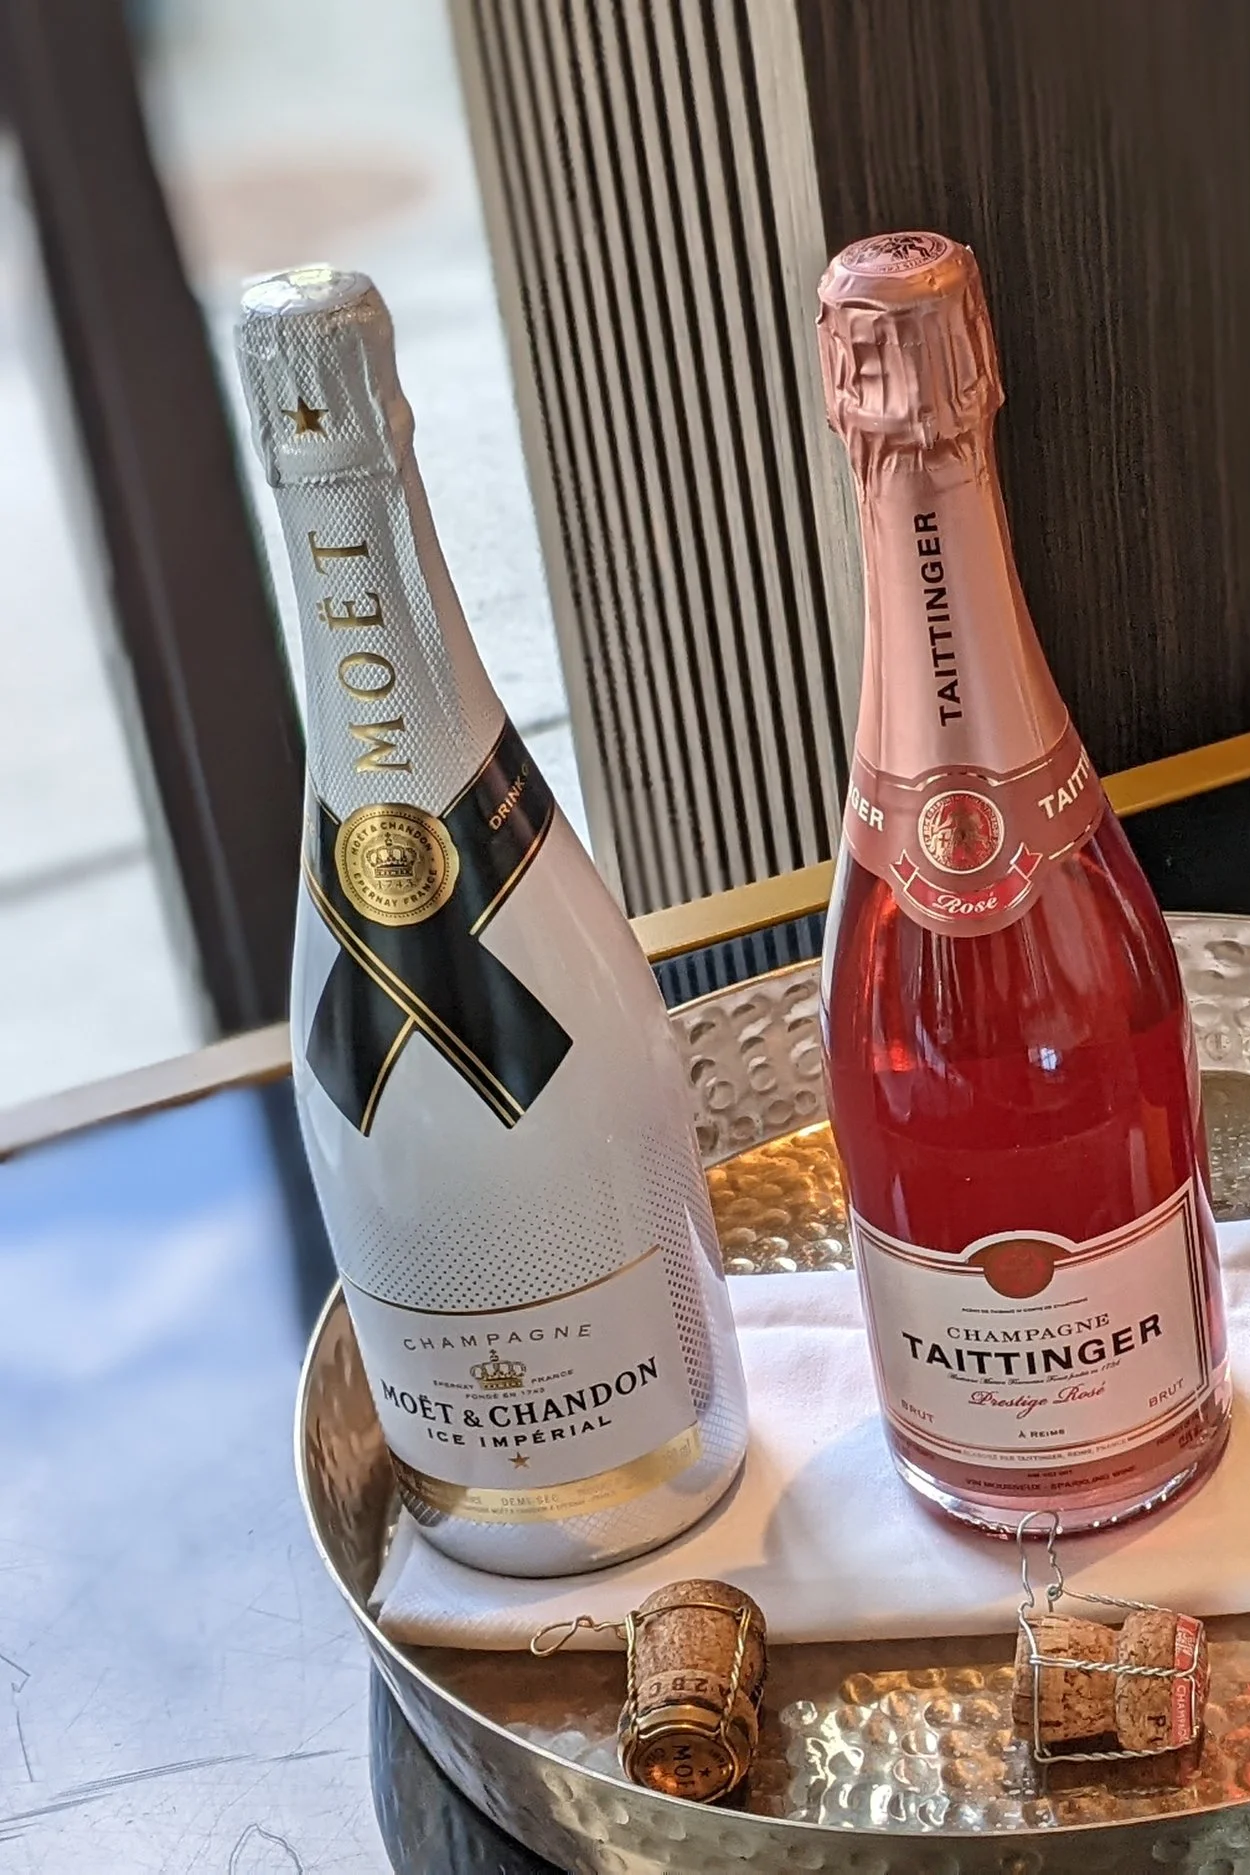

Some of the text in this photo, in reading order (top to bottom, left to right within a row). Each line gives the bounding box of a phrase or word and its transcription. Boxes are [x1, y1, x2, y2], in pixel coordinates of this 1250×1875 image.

[913, 511, 963, 727] TAITTINGER
[308, 531, 412, 775] MOËT
[489, 775, 525, 830] DRINK
[380, 821, 433, 852] CHANDON
[403, 868, 437, 905] FRANCE
[931, 891, 998, 915] Rosé
[403, 1324, 592, 1351] CHAMPAGNE
[946, 1312, 1111, 1344] CHAMPAGNE
[901, 1313, 1164, 1377] TAITTINGER
[380, 1356, 660, 1429] MOËT & CHANDON
[531, 1369, 575, 1384] FRANCE
[1148, 1378, 1184, 1408] BRUT
[901, 1399, 934, 1424] BRUT
[967, 1381, 1106, 1420] Prestige Rosé
[427, 1415, 613, 1449] ICE IMPÉRIAL
[1030, 1429, 1066, 1439] REIMS
